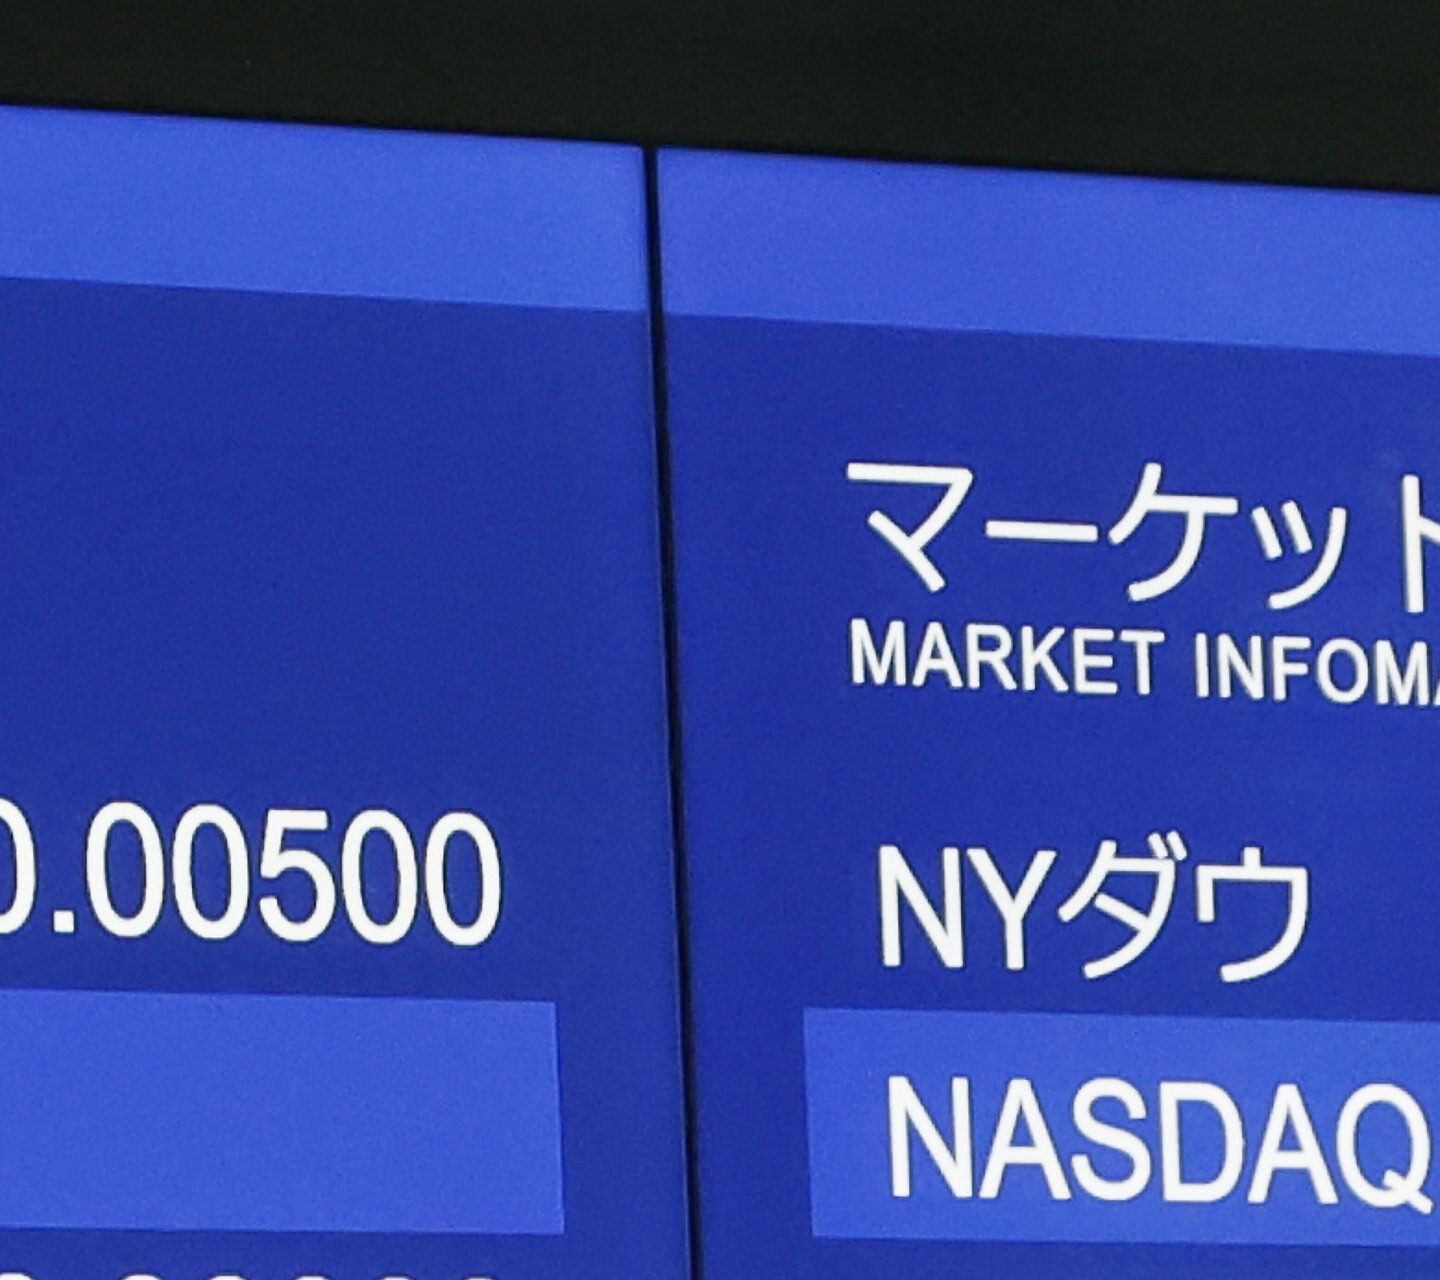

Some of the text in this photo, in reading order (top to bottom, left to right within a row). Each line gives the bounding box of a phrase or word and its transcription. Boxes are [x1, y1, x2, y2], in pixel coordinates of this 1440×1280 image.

[850, 617, 1166, 696] MARKET
[878, 829, 1309, 984] NYダウ
[887, 1075, 1434, 1215] NASDAQ
